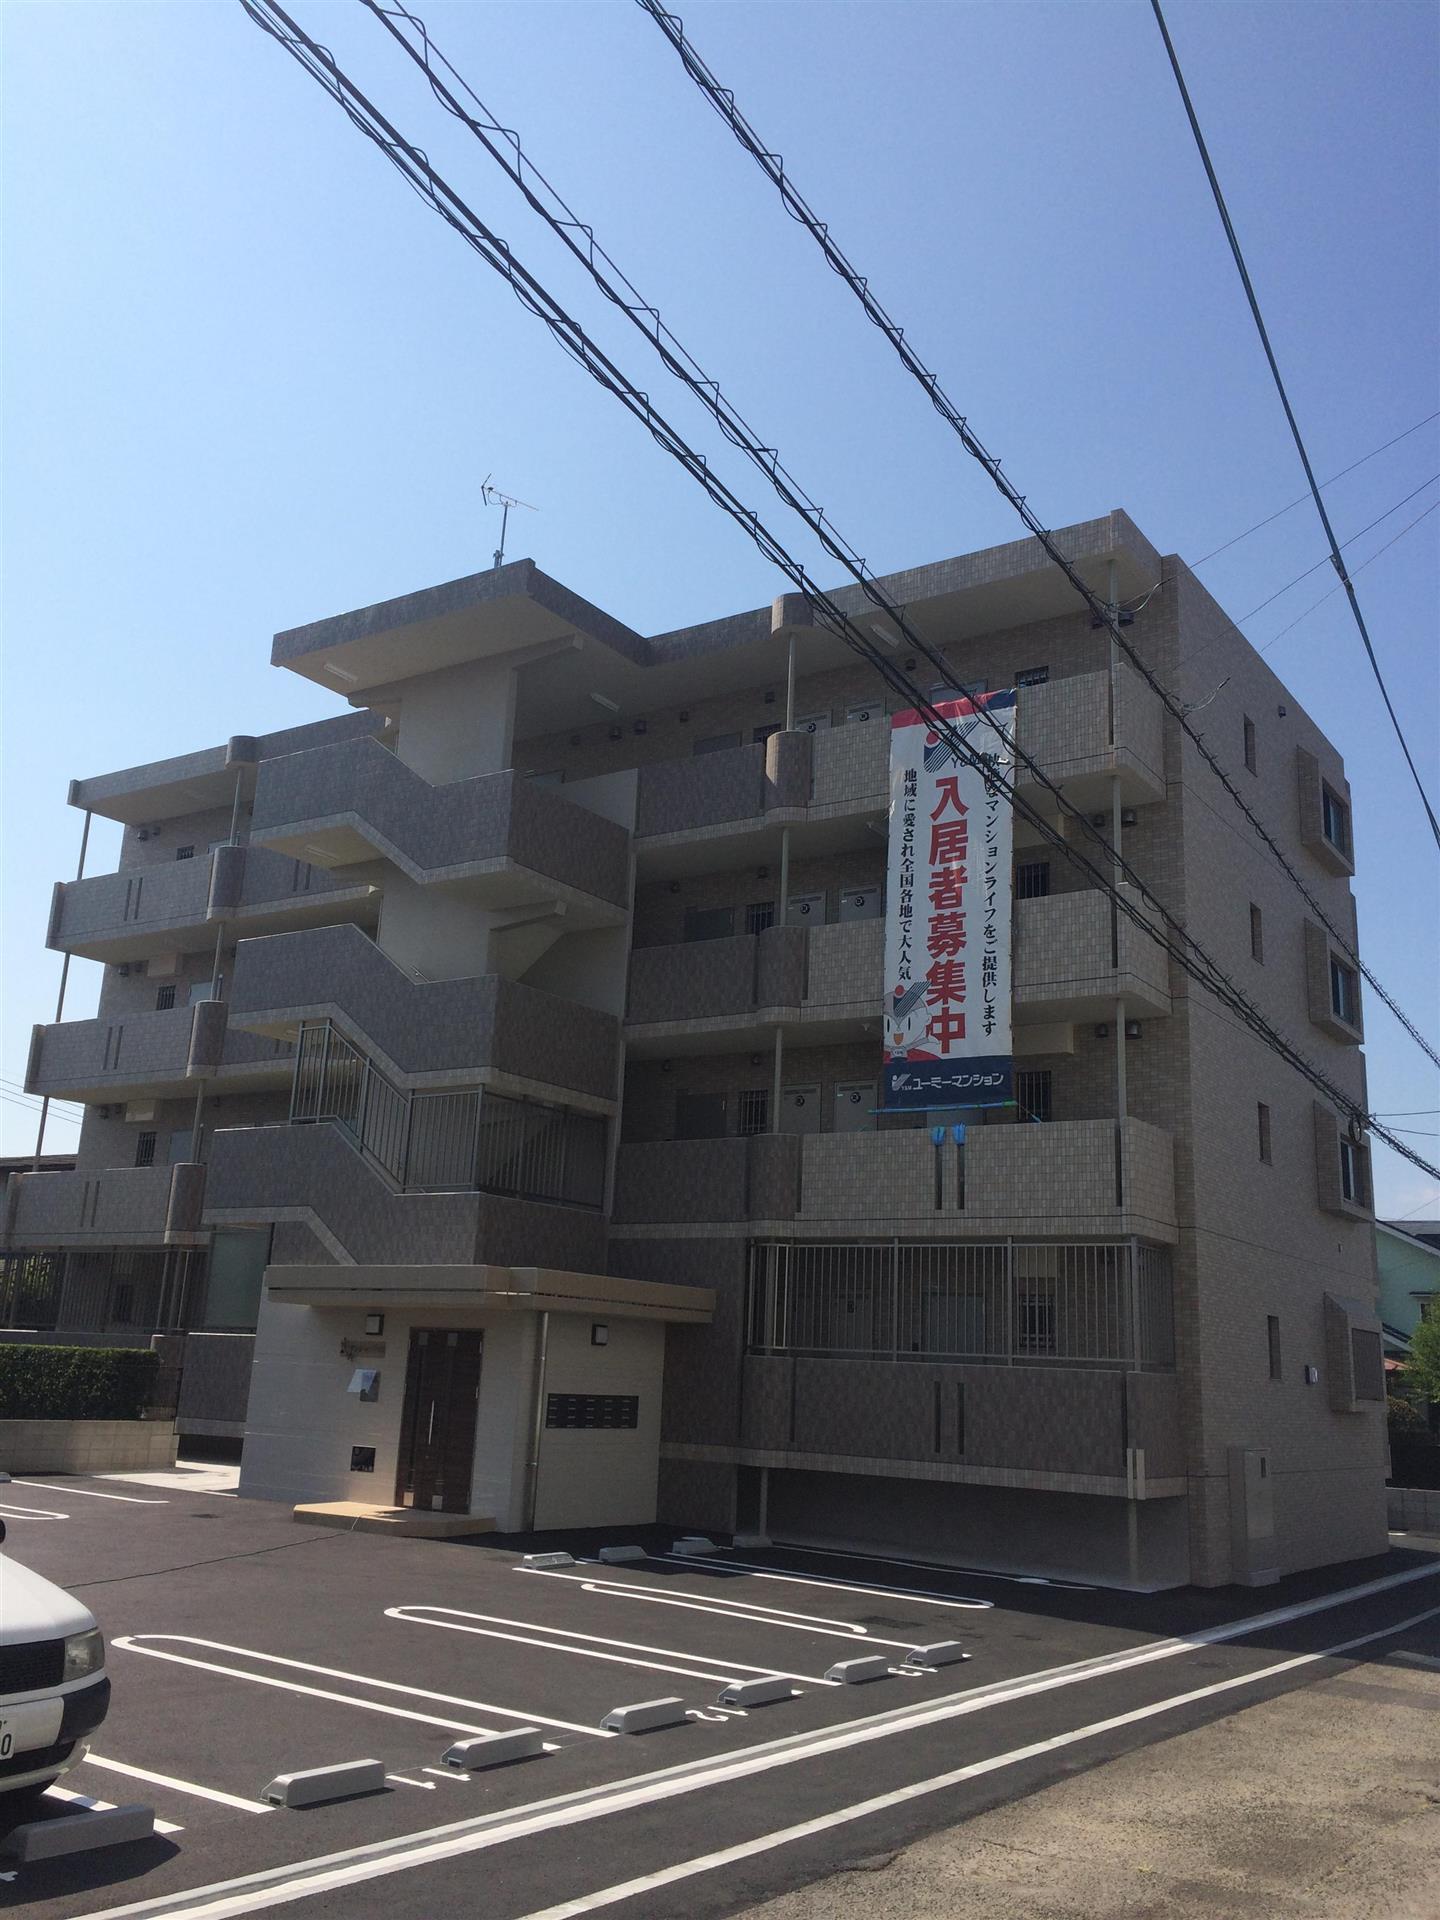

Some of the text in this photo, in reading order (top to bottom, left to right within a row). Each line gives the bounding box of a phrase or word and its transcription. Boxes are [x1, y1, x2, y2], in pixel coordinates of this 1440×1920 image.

[898, 768, 918, 980] 地域に愛され全国各地で大人気
[925, 776, 970, 1054] 入居者募集中
[912, 1073, 1004, 1090] ユーミーマンション
